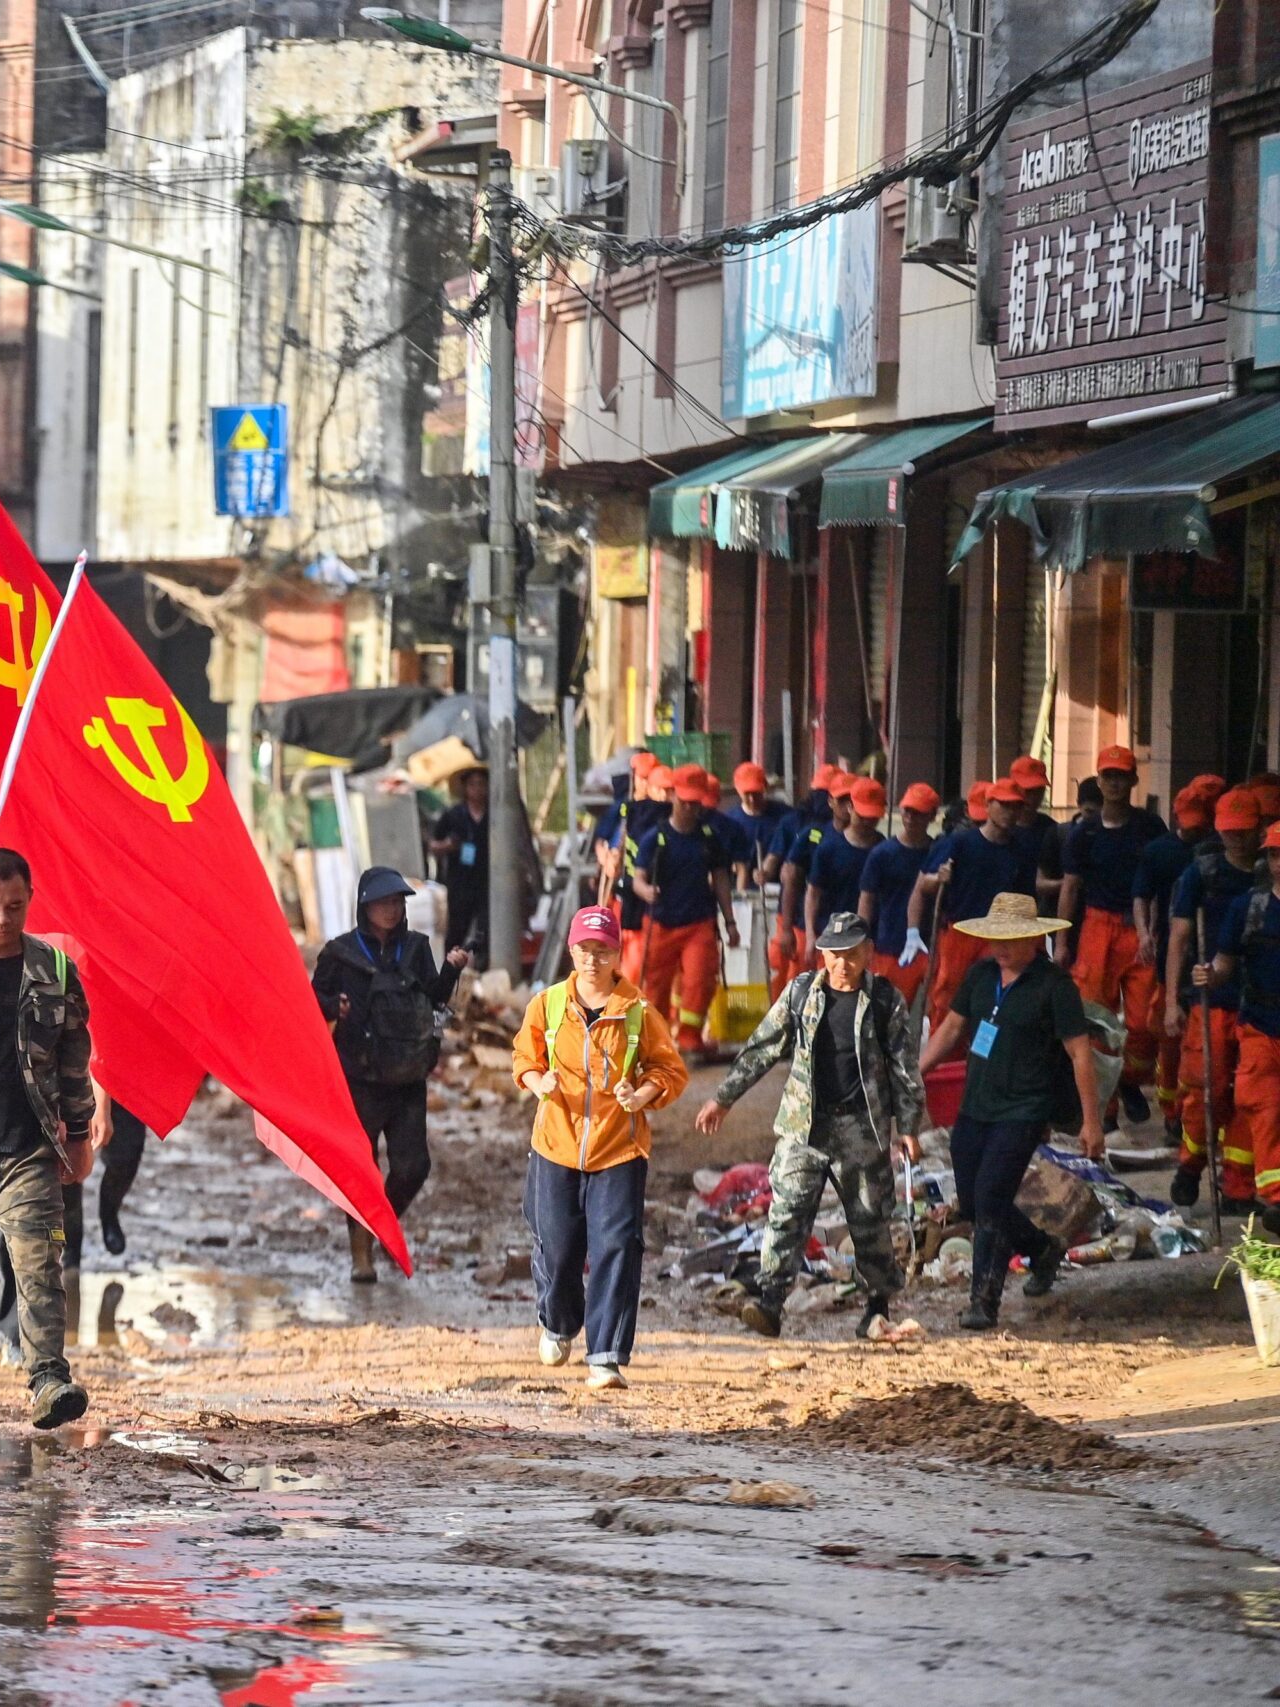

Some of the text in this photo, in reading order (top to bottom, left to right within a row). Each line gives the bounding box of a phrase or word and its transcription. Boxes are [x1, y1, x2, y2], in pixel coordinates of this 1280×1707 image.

[1008, 198, 1206, 357] 镇龙汽车养护中心
